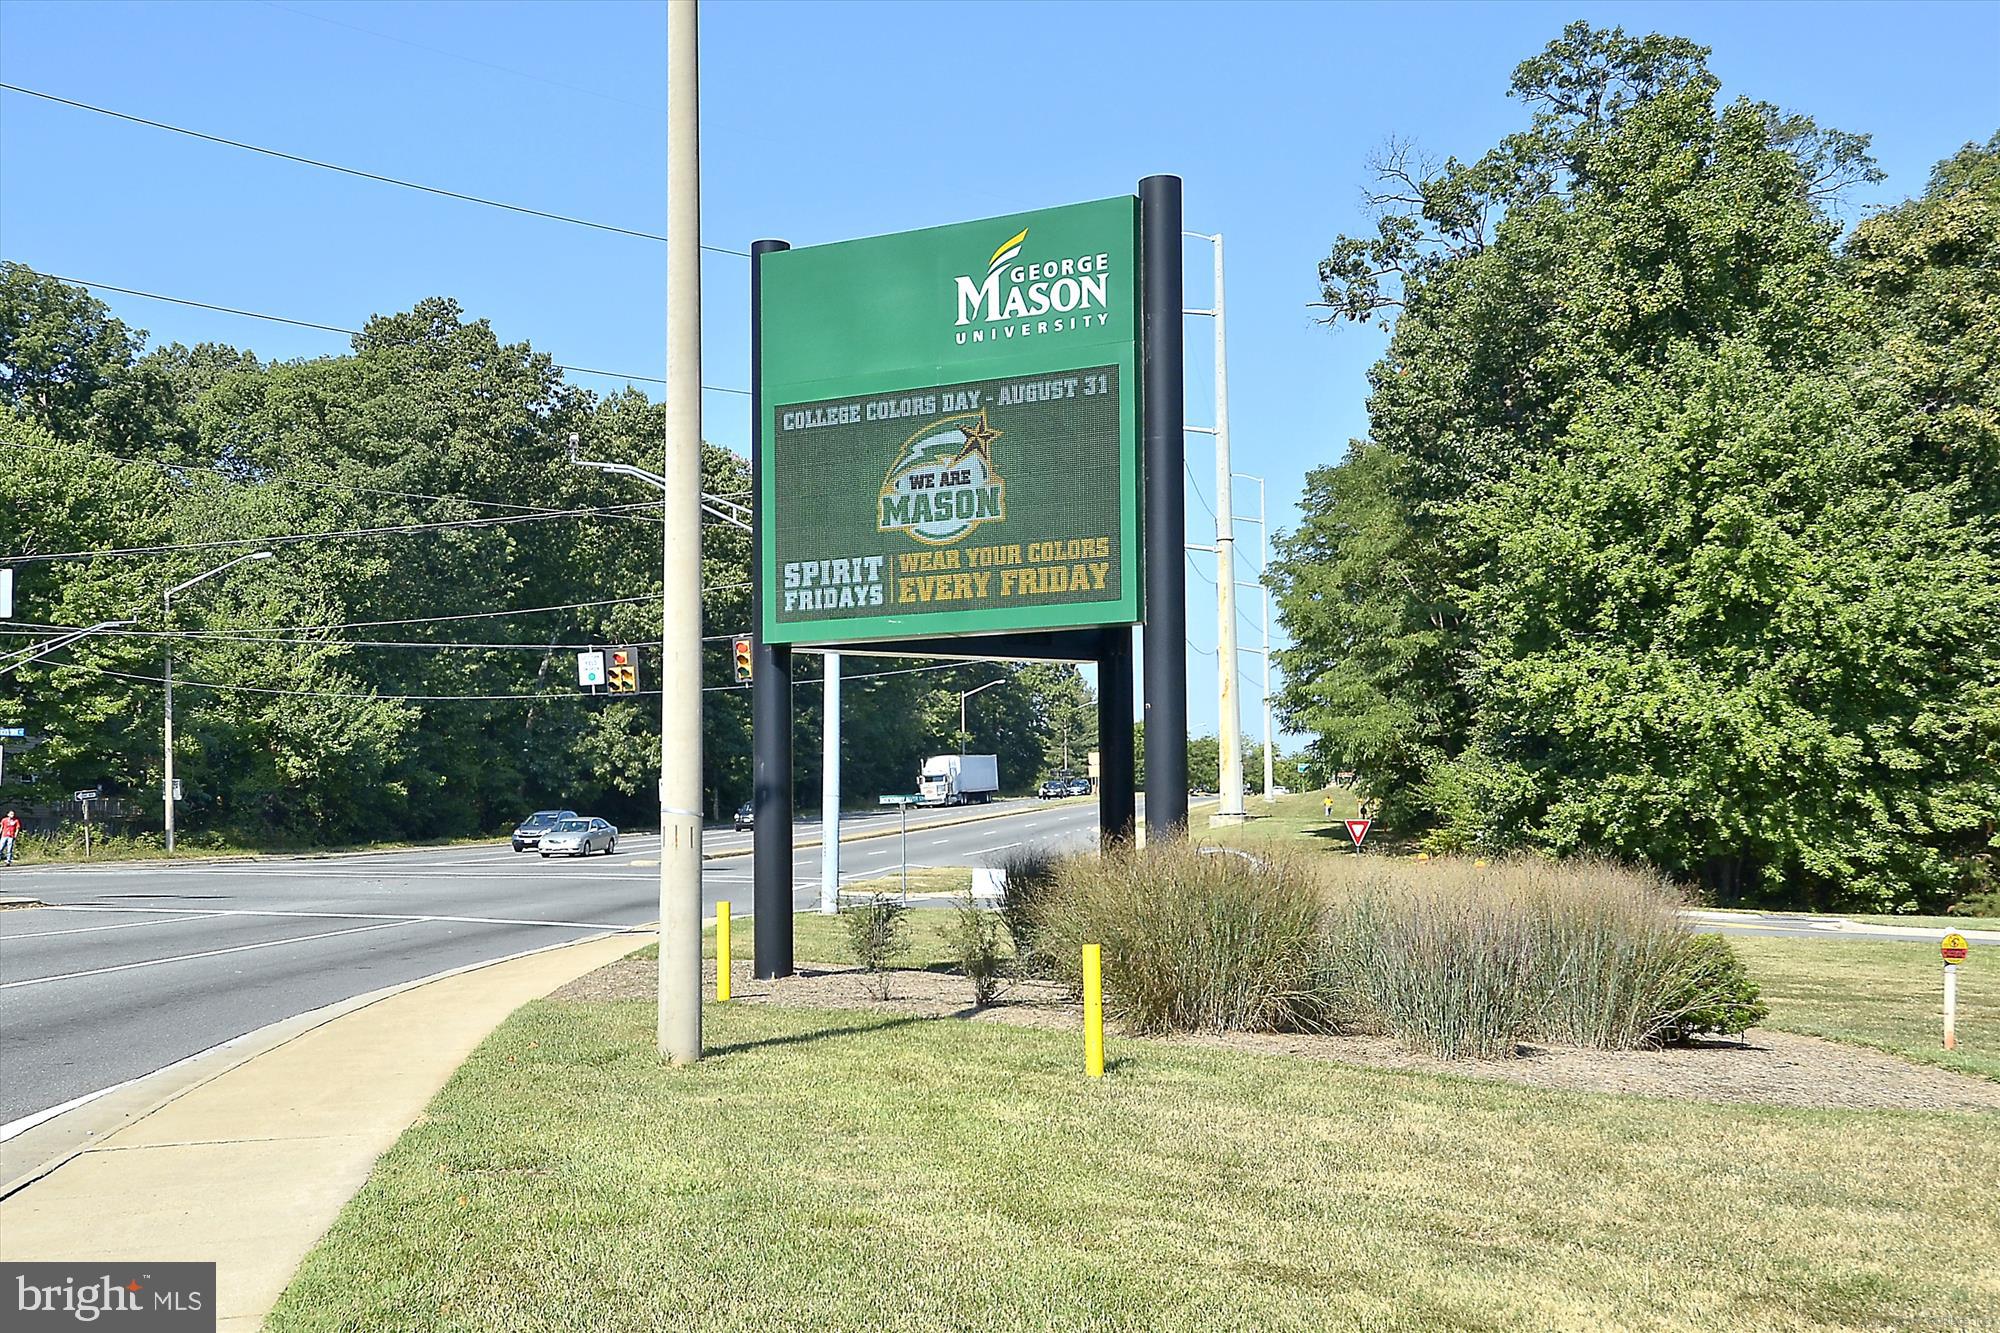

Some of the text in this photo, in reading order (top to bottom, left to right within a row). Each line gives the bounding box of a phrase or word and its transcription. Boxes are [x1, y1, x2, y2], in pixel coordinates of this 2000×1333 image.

[1010, 253, 1108, 283] GEORGE
[954, 263, 1110, 326] MASON
[955, 313, 1108, 345] UNIVERSITY
[783, 404, 861, 430] COLLEGE
[866, 395, 936, 421] COLORS
[942, 389, 981, 412] DAY
[997, 377, 1078, 405] AUGUST
[1083, 374, 1108, 396] 31
[909, 469, 971, 490] WE ARE
[882, 486, 1001, 526] MASON
[784, 555, 883, 588] SPIRIT
[898, 536, 1110, 573] WEAR YOUR COLORS
[784, 583, 883, 612] FRIDAYS
[898, 562, 1109, 604] EVERY FRIDAY
